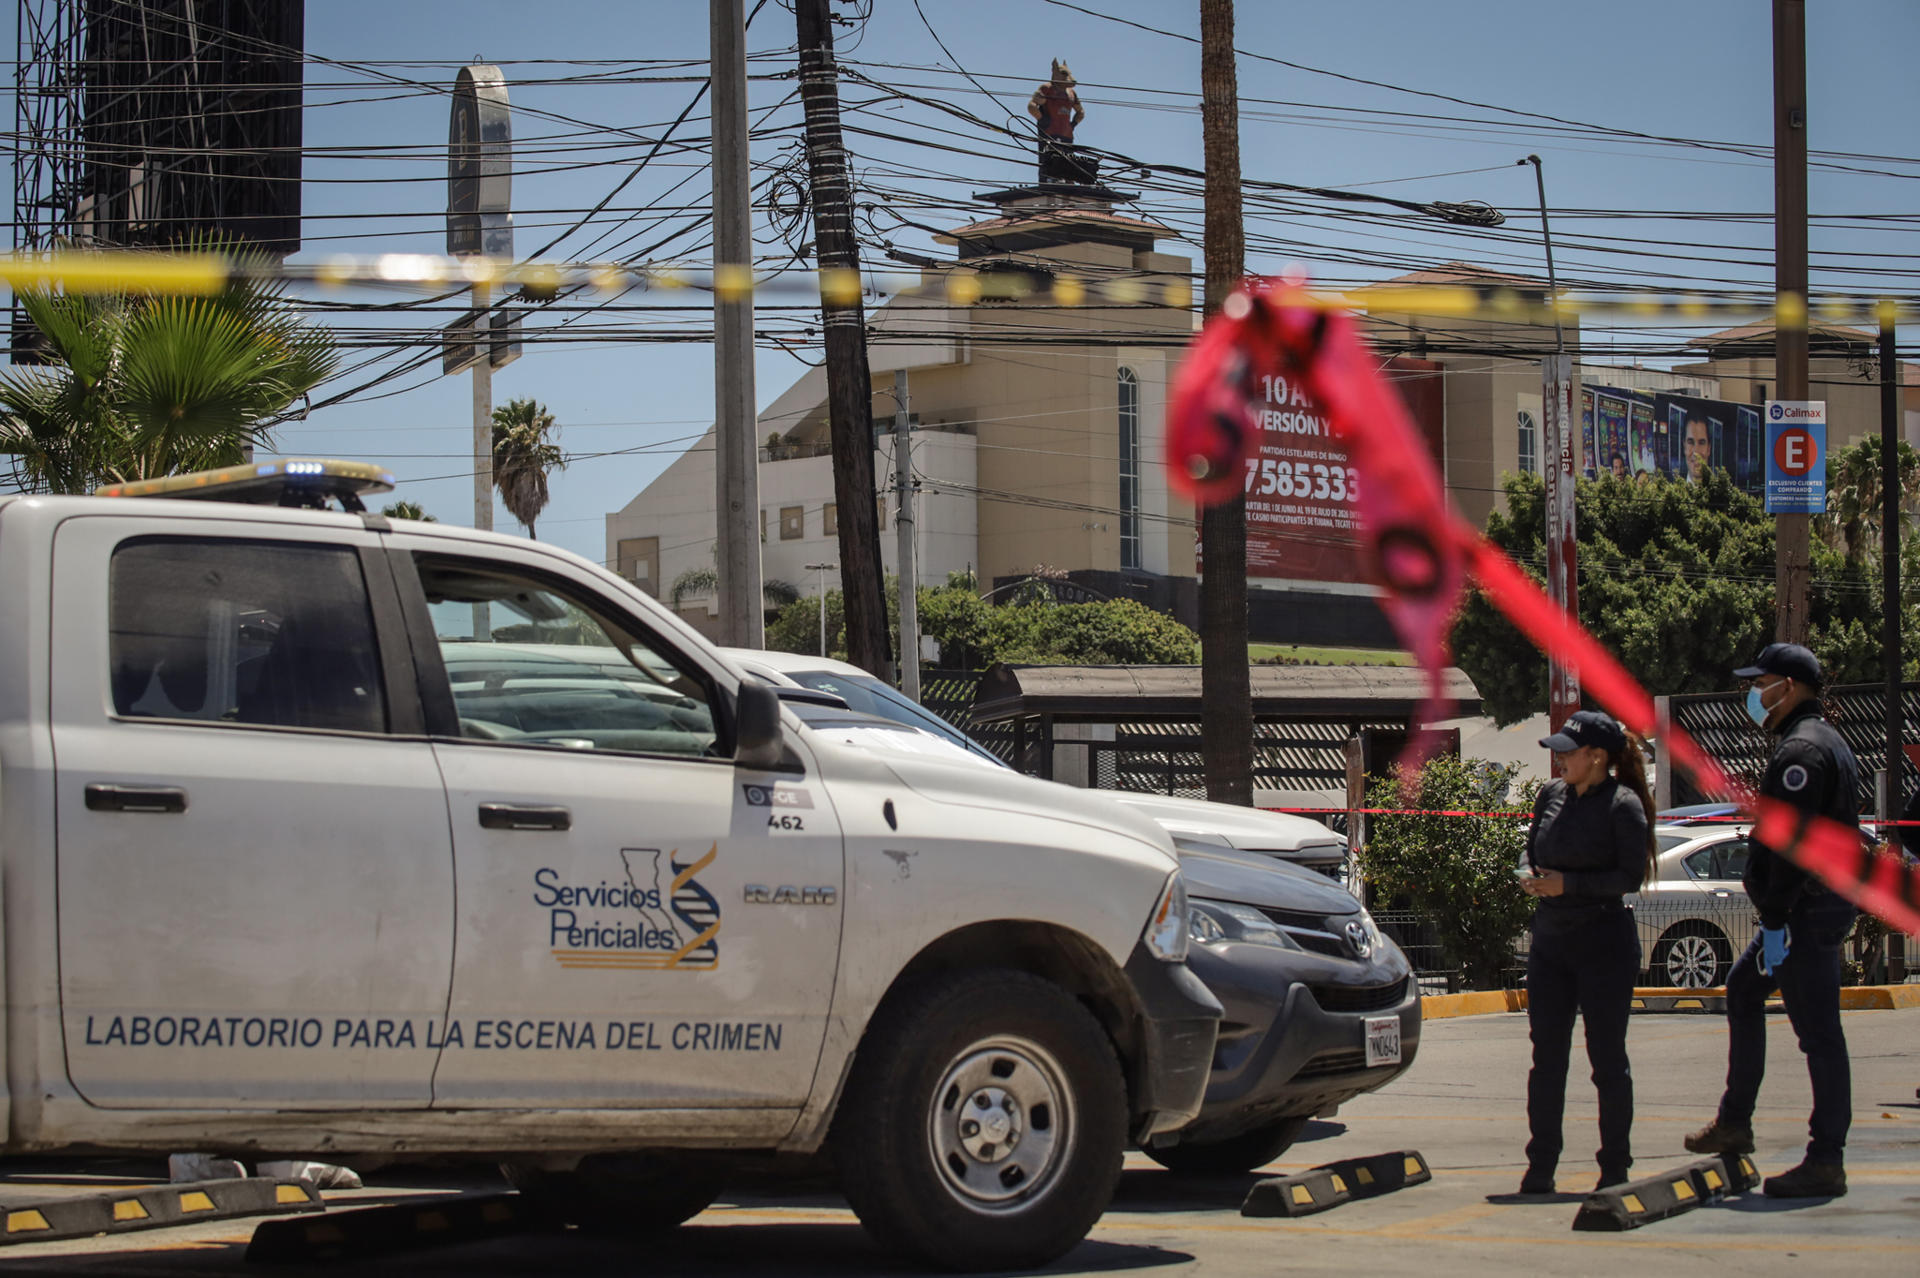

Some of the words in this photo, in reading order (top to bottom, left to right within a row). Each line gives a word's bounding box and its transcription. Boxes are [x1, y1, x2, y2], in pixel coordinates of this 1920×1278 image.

[1262, 375, 1287, 404] 10
[1560, 380, 1572, 472] Emergencia
[1784, 407, 1821, 418] Calimax
[1259, 446, 1286, 457] PARTIDAS
[1286, 449, 1318, 460] ESTELARES
[1318, 452, 1327, 460] DE
[1328, 453, 1347, 462] BINGO
[1546, 382, 1559, 538] Emergencia
[1785, 436, 1804, 468] E
[1245, 501, 1262, 511] ARTIR
[767, 815, 804, 831] 462
[534, 867, 662, 909] Servicios
[744, 883, 836, 906] RAM
[551, 908, 675, 950] Periciales
[85, 1016, 323, 1047] LABORATORIO
[332, 1019, 416, 1048] PARA
[426, 1020, 465, 1049] LA
[474, 1020, 597, 1050] ESCENA
[606, 1022, 662, 1050] DEL
[671, 1022, 783, 1051] CRIMEN
